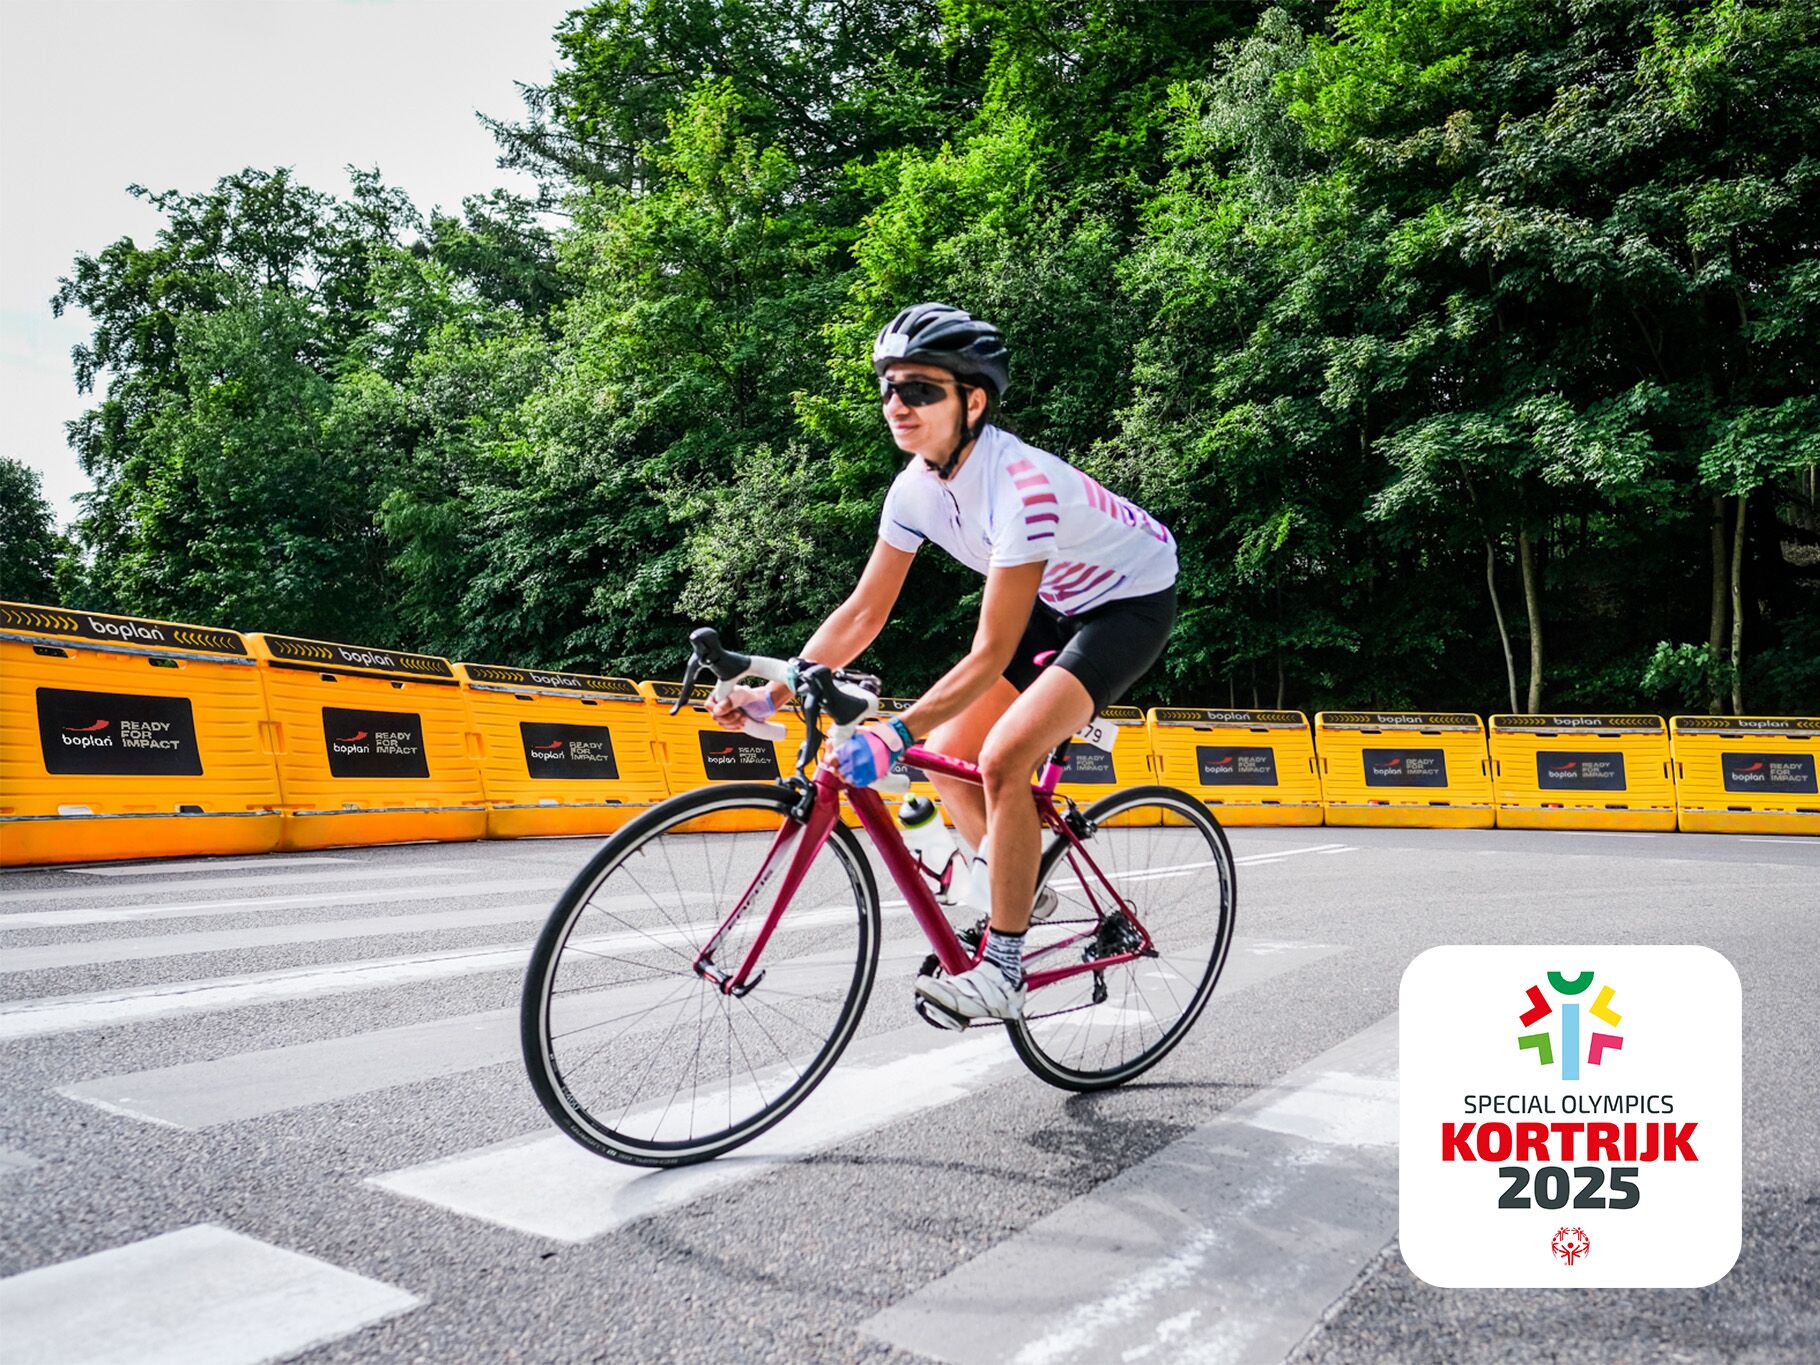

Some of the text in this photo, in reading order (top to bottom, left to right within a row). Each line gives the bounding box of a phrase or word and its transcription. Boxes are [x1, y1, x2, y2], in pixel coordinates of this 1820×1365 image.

[88, 617, 165, 641] boplan
[338, 648, 395, 667] boplan
[529, 672, 582, 688] boplan
[1208, 711, 1250, 721] boplan
[1377, 715, 1423, 724] boplan
[121, 720, 171, 732] READY
[1553, 717, 1601, 727] boplan
[1738, 720, 1789, 728] boplan
[121, 730, 152, 740] FOR
[375, 732, 411, 741] READY
[1076, 724, 1103, 743] 79
[62, 734, 113, 748] boplan
[122, 739, 180, 750] IMPACT
[376, 739, 398, 747] FOR
[569, 741, 603, 749] READY
[333, 743, 369, 755] boplan
[376, 746, 418, 755] IMPACT
[570, 747, 591, 755] FOR
[531, 750, 565, 761] boplan
[571, 754, 609, 762] IMPACT
[707, 756, 736, 765] boplan
[1204, 765, 1233, 774] boplan
[1373, 767, 1402, 776] boplan
[1548, 770, 1577, 779] boplan
[1731, 772, 1765, 782] boplan
